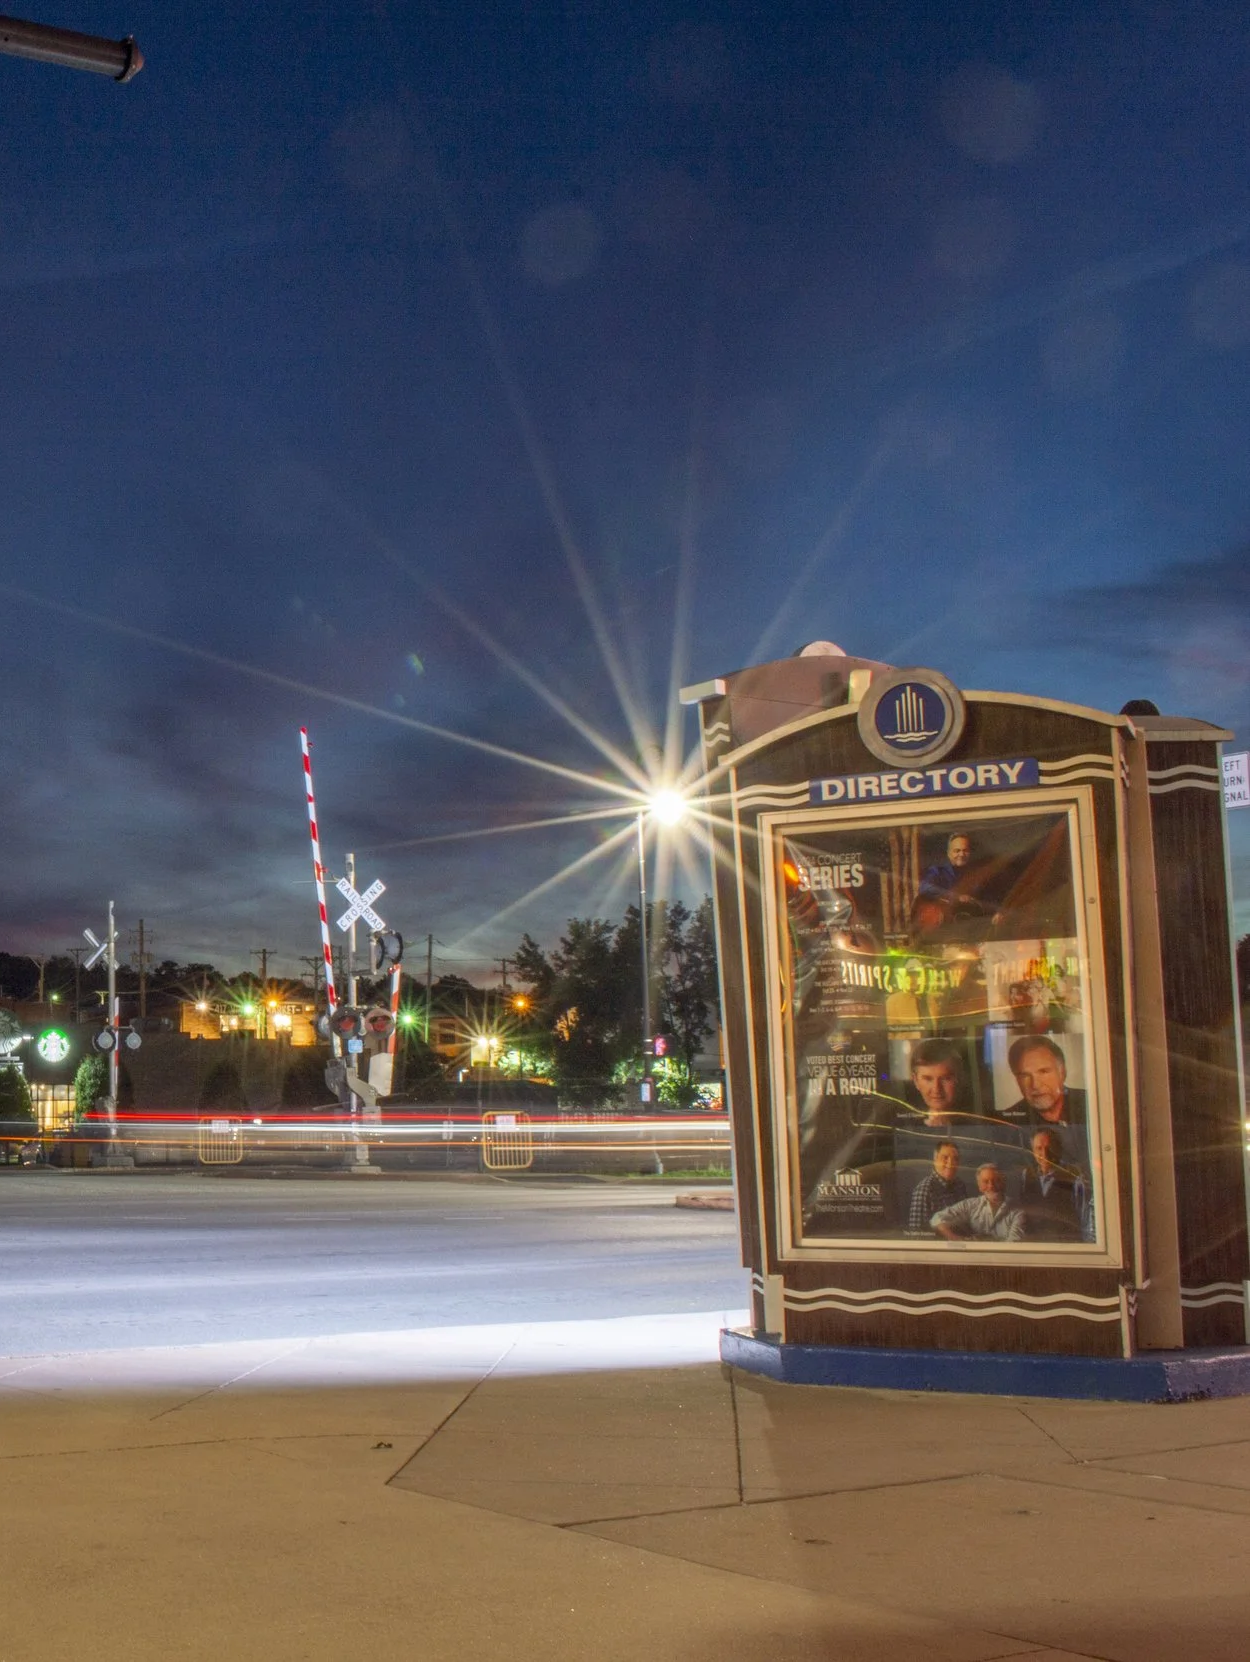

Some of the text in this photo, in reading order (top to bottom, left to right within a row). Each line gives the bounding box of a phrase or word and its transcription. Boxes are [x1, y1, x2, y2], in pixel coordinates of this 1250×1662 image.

[1224, 760, 1240, 772] EFT
[820, 761, 1025, 801] DIRECTORY
[1223, 776, 1243, 787] URN
[1224, 791, 1249, 803] GNAL
[798, 864, 865, 892] SERIES
[340, 882, 383, 928] CROSSING
[806, 1053, 876, 1065] VOTED BEST CONCERT
[838, 1065, 846, 1077] 6
[846, 1064, 877, 1077] YEARS
[825, 1078, 837, 1096] A
[817, 1185, 881, 1196] MANSION
